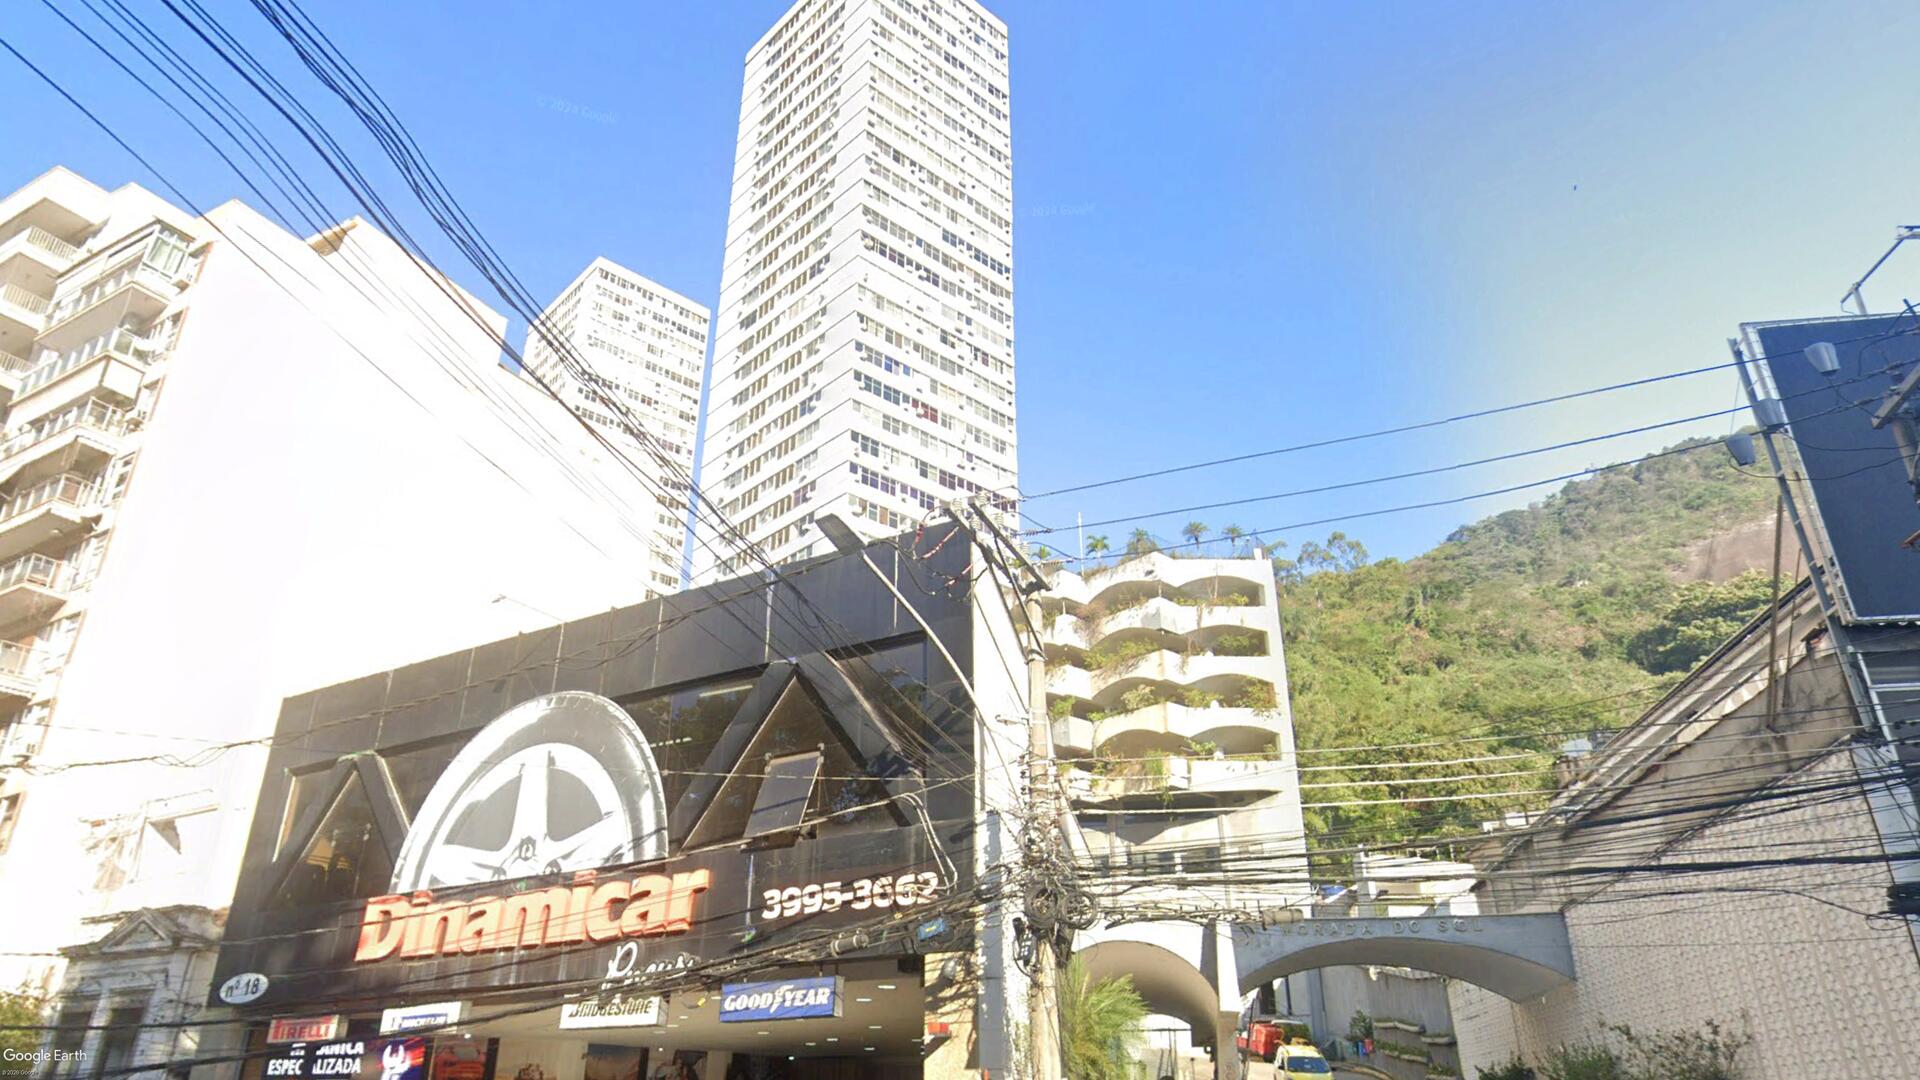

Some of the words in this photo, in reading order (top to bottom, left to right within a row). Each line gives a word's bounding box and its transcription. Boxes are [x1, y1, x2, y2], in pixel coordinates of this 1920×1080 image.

[762, 871, 939, 919] 3995-3662
[354, 869, 711, 962] Dinamicar
[1392, 920, 1421, 934] DO
[1438, 919, 1483, 933] SOL
[244, 977, 260, 996] 18
[723, 984, 832, 1013] GOODYEAR
[272, 1018, 334, 1040] PIRELLI
[267, 1059, 362, 1076] ESPECALIZADA
